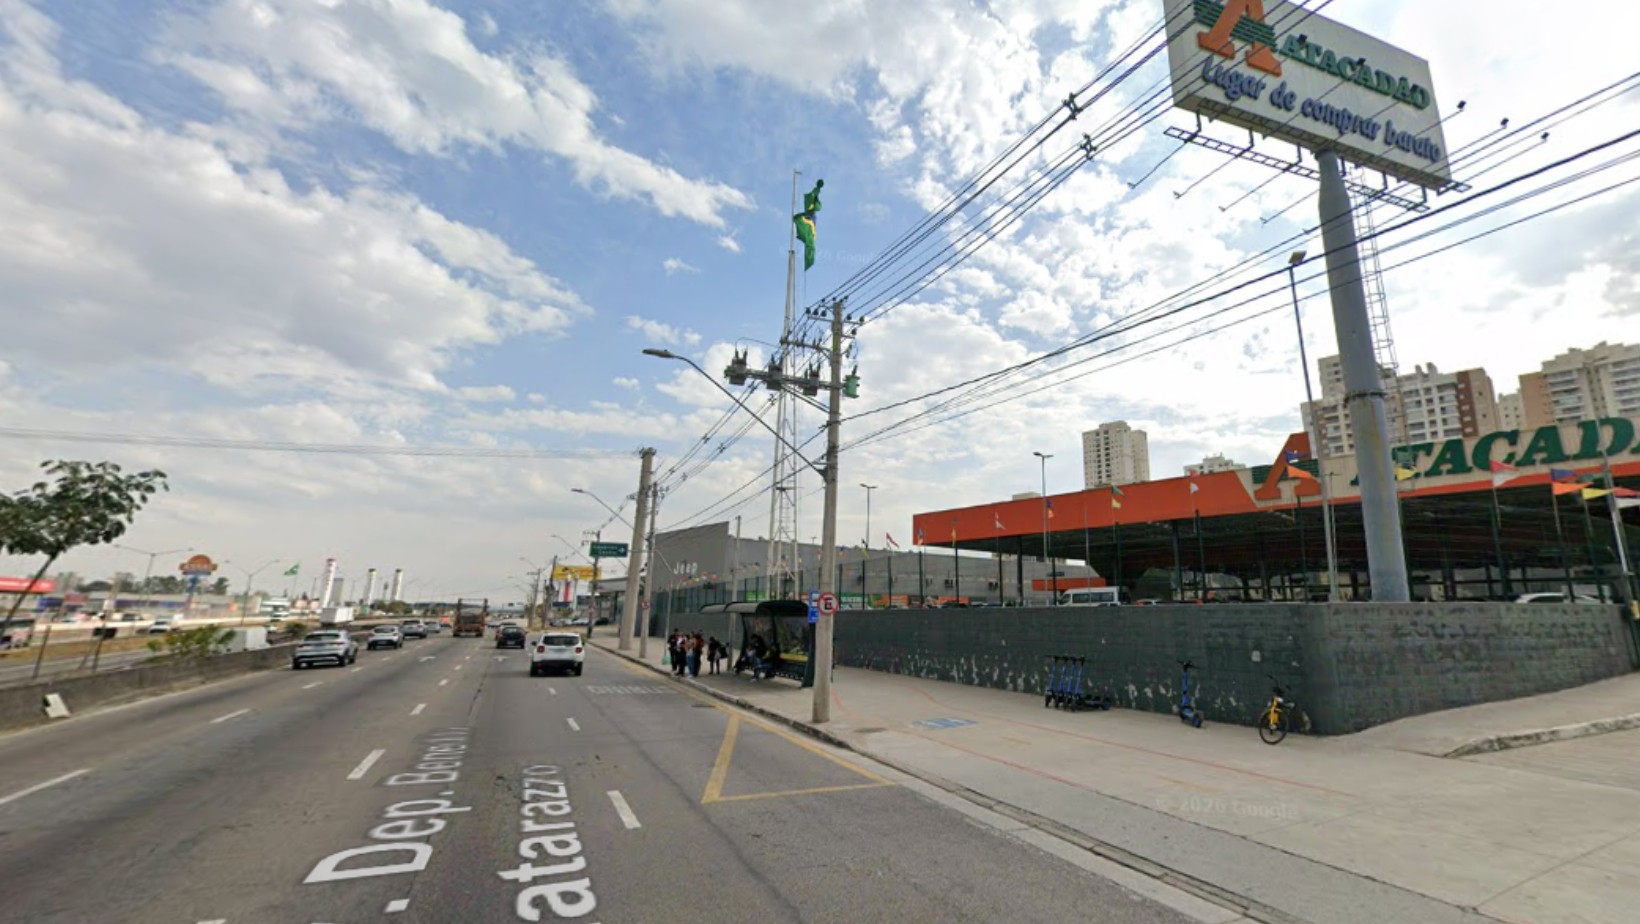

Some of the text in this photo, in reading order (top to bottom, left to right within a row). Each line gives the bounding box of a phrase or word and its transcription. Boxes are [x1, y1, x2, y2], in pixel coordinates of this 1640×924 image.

[1202, 54, 1439, 163] Lugar de comprar barato
[1350, 417, 1640, 486] TACAD
[673, 560, 699, 577] Jeep
